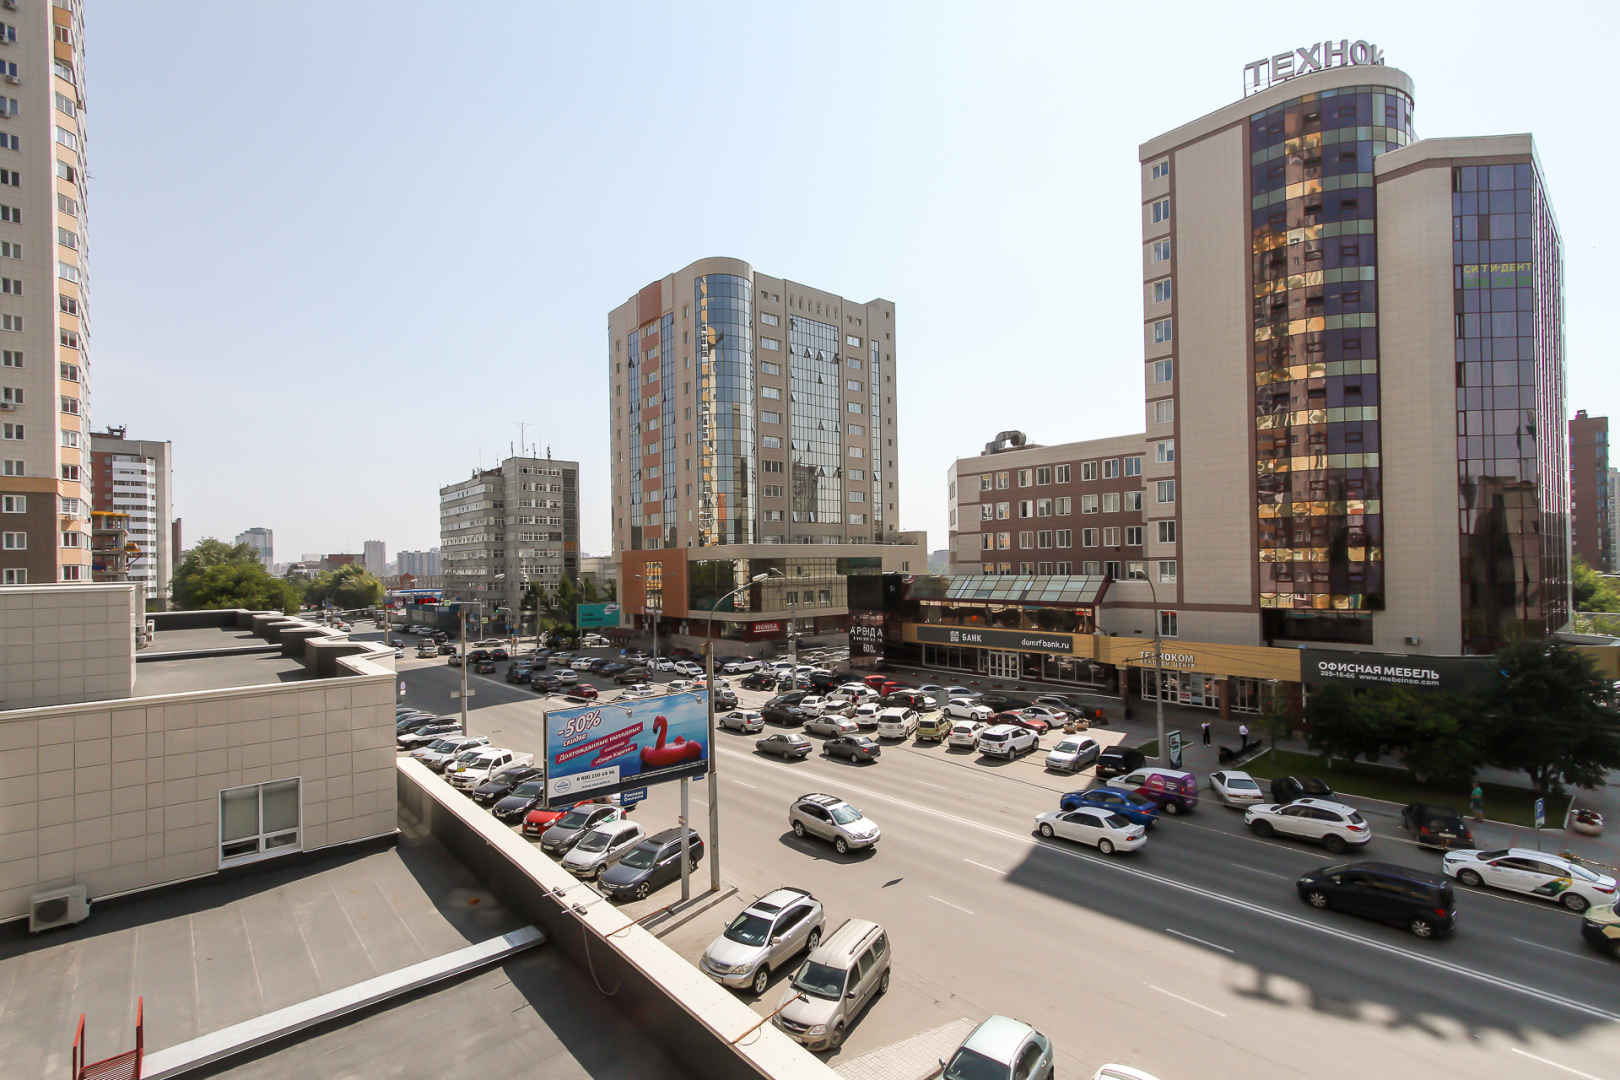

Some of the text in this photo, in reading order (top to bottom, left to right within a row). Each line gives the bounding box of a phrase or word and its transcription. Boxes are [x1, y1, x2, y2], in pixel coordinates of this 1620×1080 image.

[1463, 262, 1532, 274] СИТИ-ДЕНТ
[850, 626, 883, 638] АРЕНДА
[962, 633, 982, 642] БАНК
[1021, 638, 1070, 649] domrfbank.ru
[1318, 661, 1440, 680] ОФИСНАЯ МЕБЕЛЬ
[1358, 674, 1440, 686] www.mebelnso.com
[557, 709, 602, 738] -50%
[558, 726, 641, 762] Долгожданные выходные
[563, 733, 588, 747] скидка
[1537, 802, 1543, 817] P
